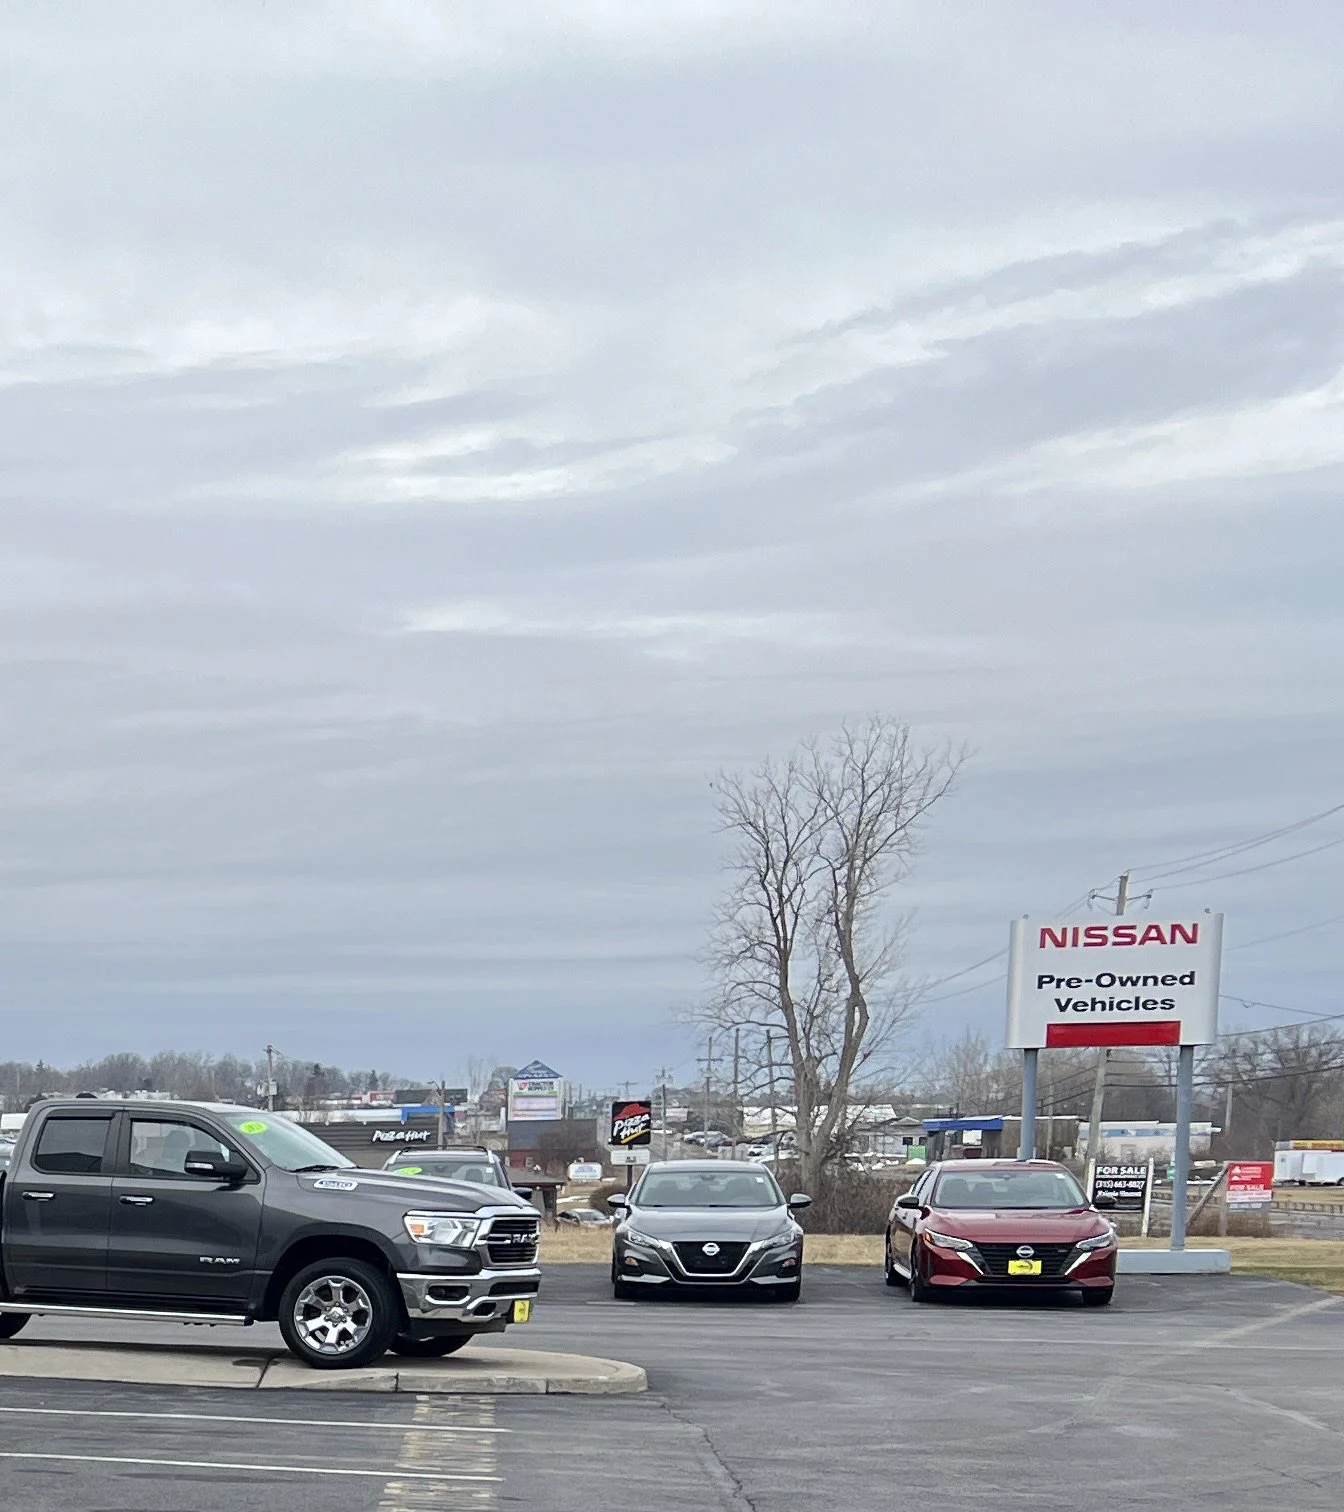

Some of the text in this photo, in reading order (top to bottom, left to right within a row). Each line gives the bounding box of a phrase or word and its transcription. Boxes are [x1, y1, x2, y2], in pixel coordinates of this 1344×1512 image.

[1038, 922, 1199, 949] NISSAN
[1036, 970, 1196, 990] Pre-Owned
[1053, 995, 1176, 1013] Vehicles
[613, 1114, 650, 1137] Pizza
[620, 1122, 647, 1140] Hut
[372, 1130, 431, 1142] Pizza Hut
[1096, 1166, 1147, 1175] FOR SALE
[199, 1256, 241, 1265] RAM
